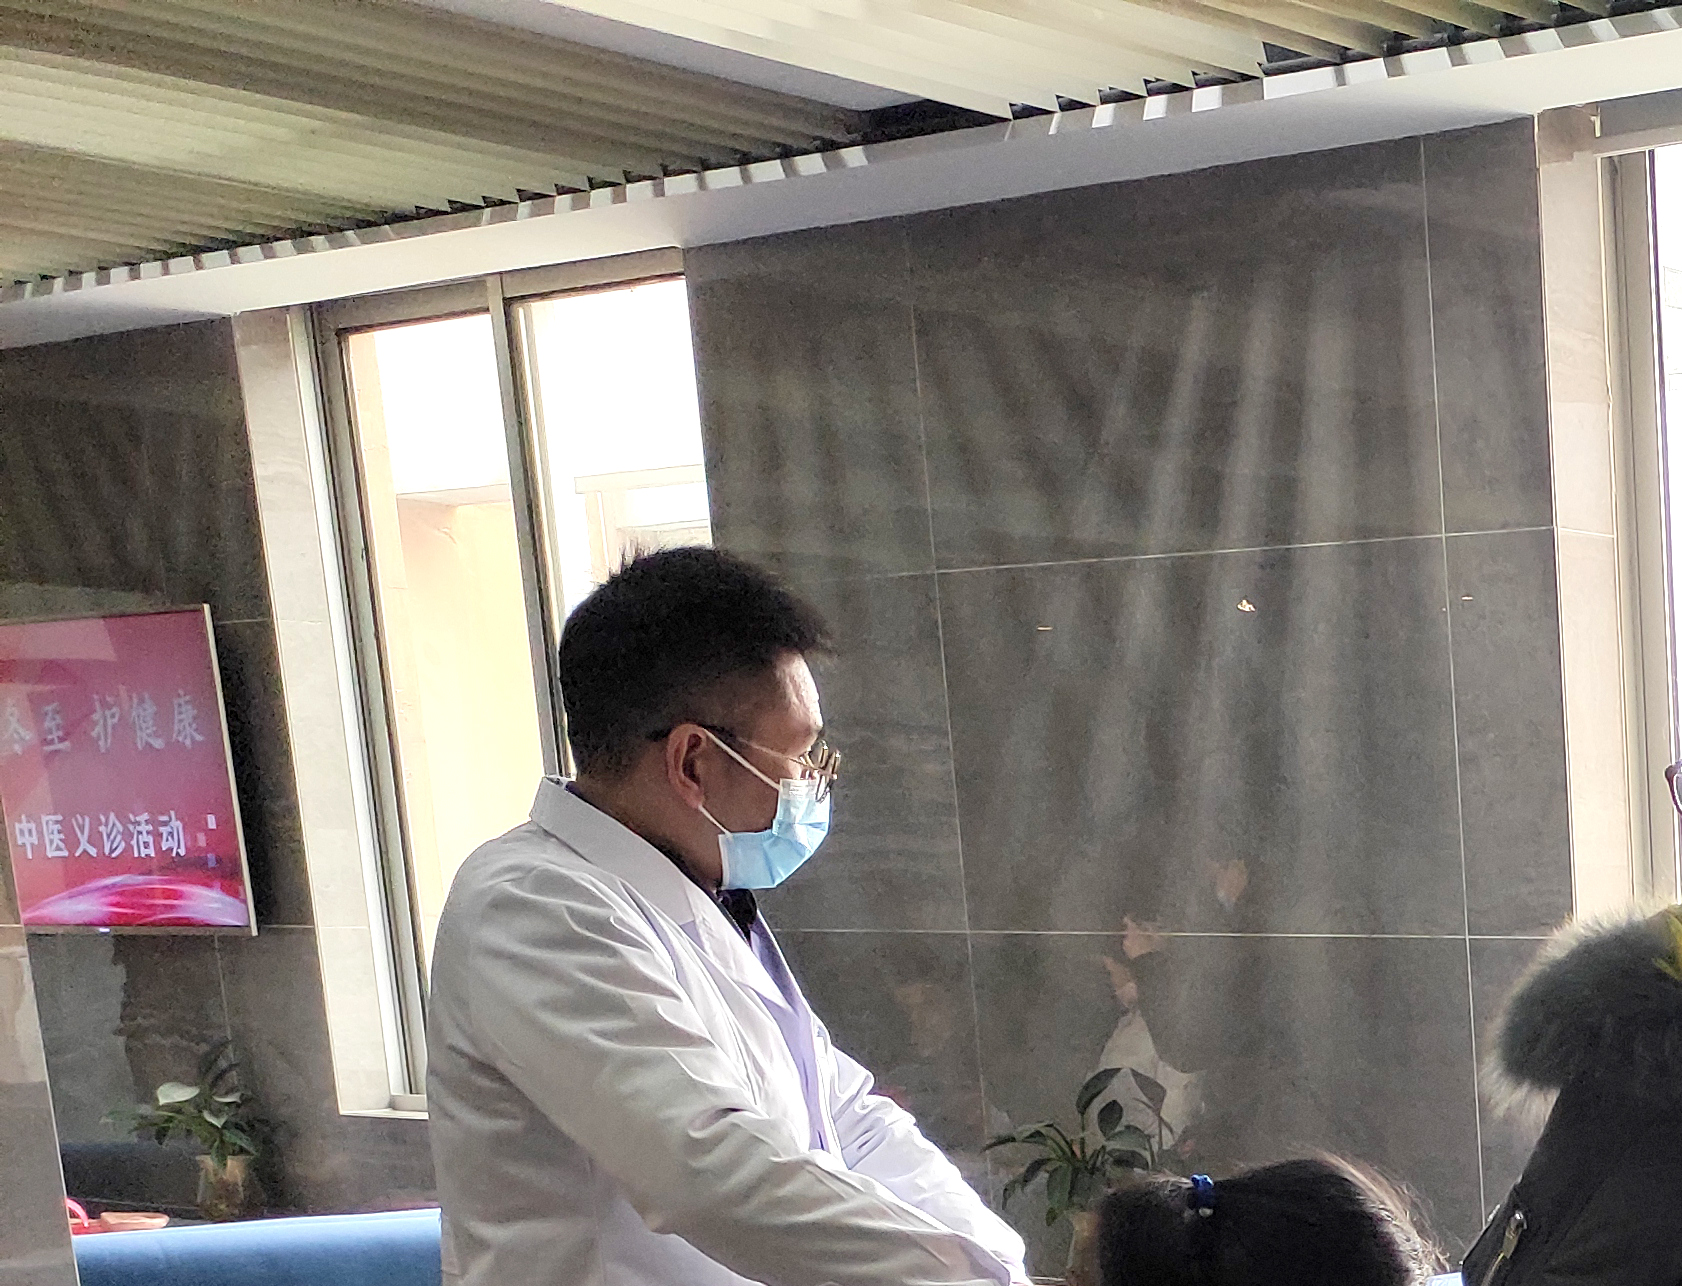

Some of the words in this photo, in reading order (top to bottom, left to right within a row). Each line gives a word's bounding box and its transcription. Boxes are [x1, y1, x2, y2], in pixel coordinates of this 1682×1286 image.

[91, 686, 206, 753] 护健康
[15, 810, 187, 860] 中医义诊活动
